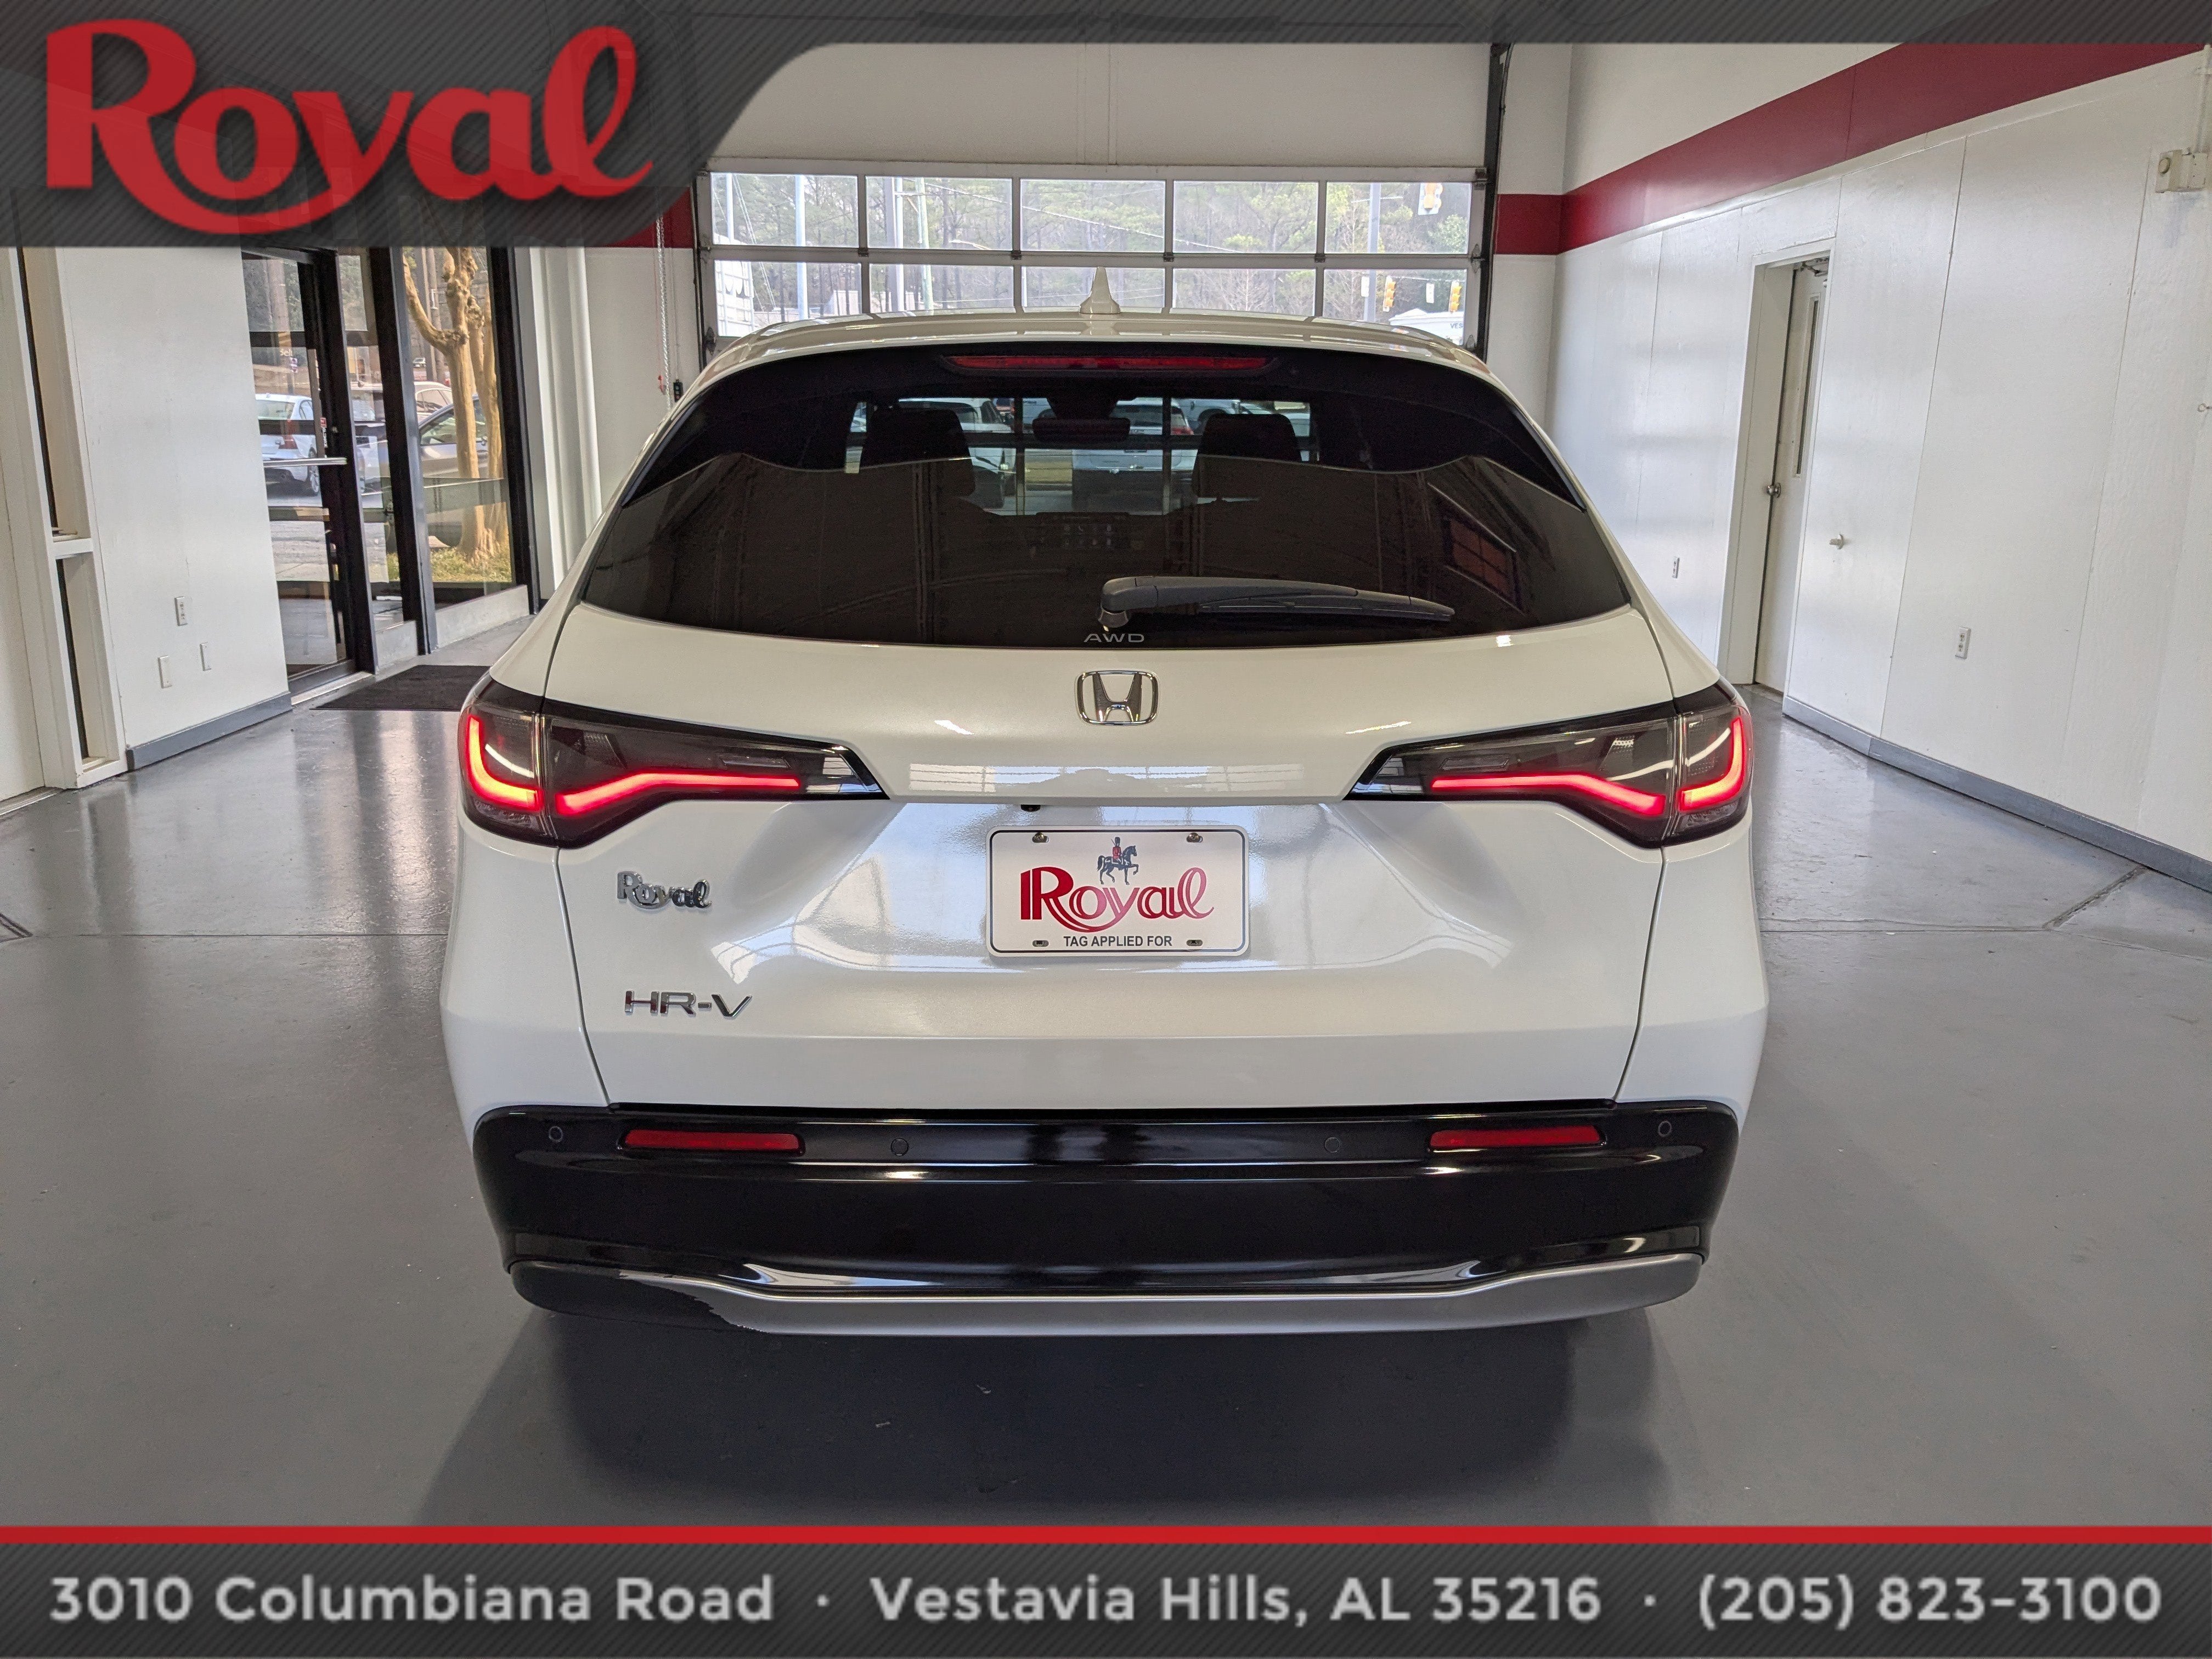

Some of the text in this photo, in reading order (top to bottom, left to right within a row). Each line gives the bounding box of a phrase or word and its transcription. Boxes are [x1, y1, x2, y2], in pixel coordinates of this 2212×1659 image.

[1084, 633, 1145, 643] AWD
[617, 871, 713, 910] Royal
[1020, 866, 1215, 933] Royal
[1063, 936, 1172, 947] TAG APPLIED FOR
[624, 990, 752, 1019] HR-V
